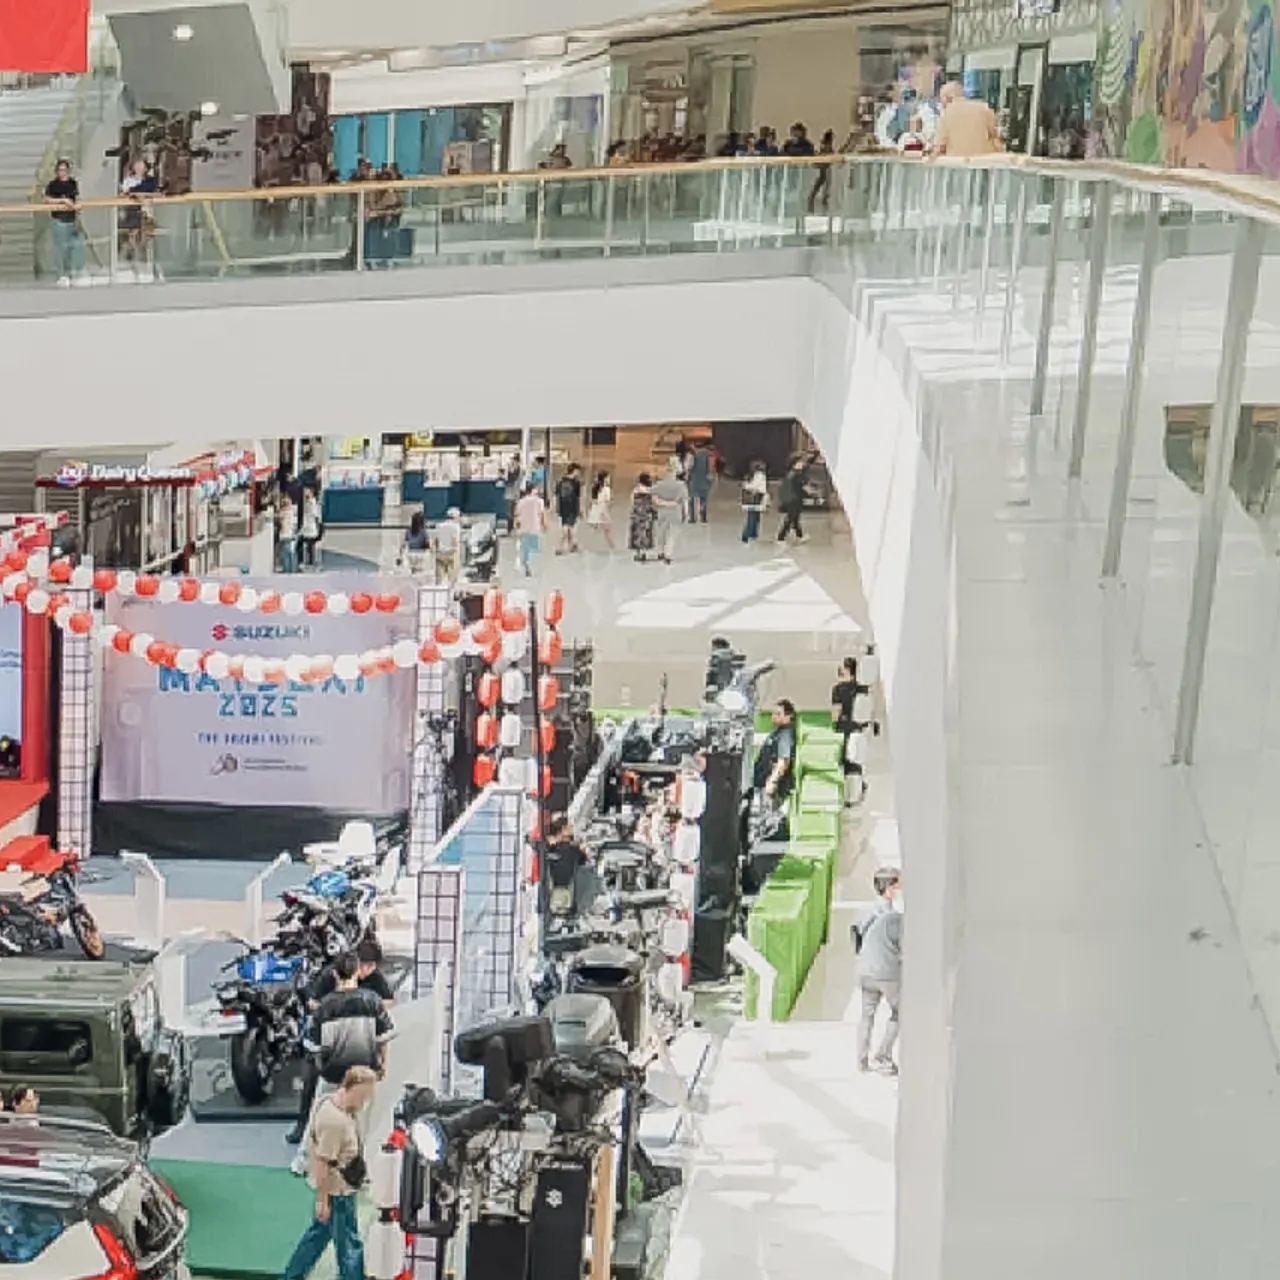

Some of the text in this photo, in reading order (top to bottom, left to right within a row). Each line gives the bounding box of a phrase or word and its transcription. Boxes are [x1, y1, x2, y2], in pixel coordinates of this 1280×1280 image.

[92, 464, 136, 481] Dairy
[138, 465, 190, 481] Queen
[233, 625, 310, 640] SUZUKI
[219, 692, 298, 717] 2025
